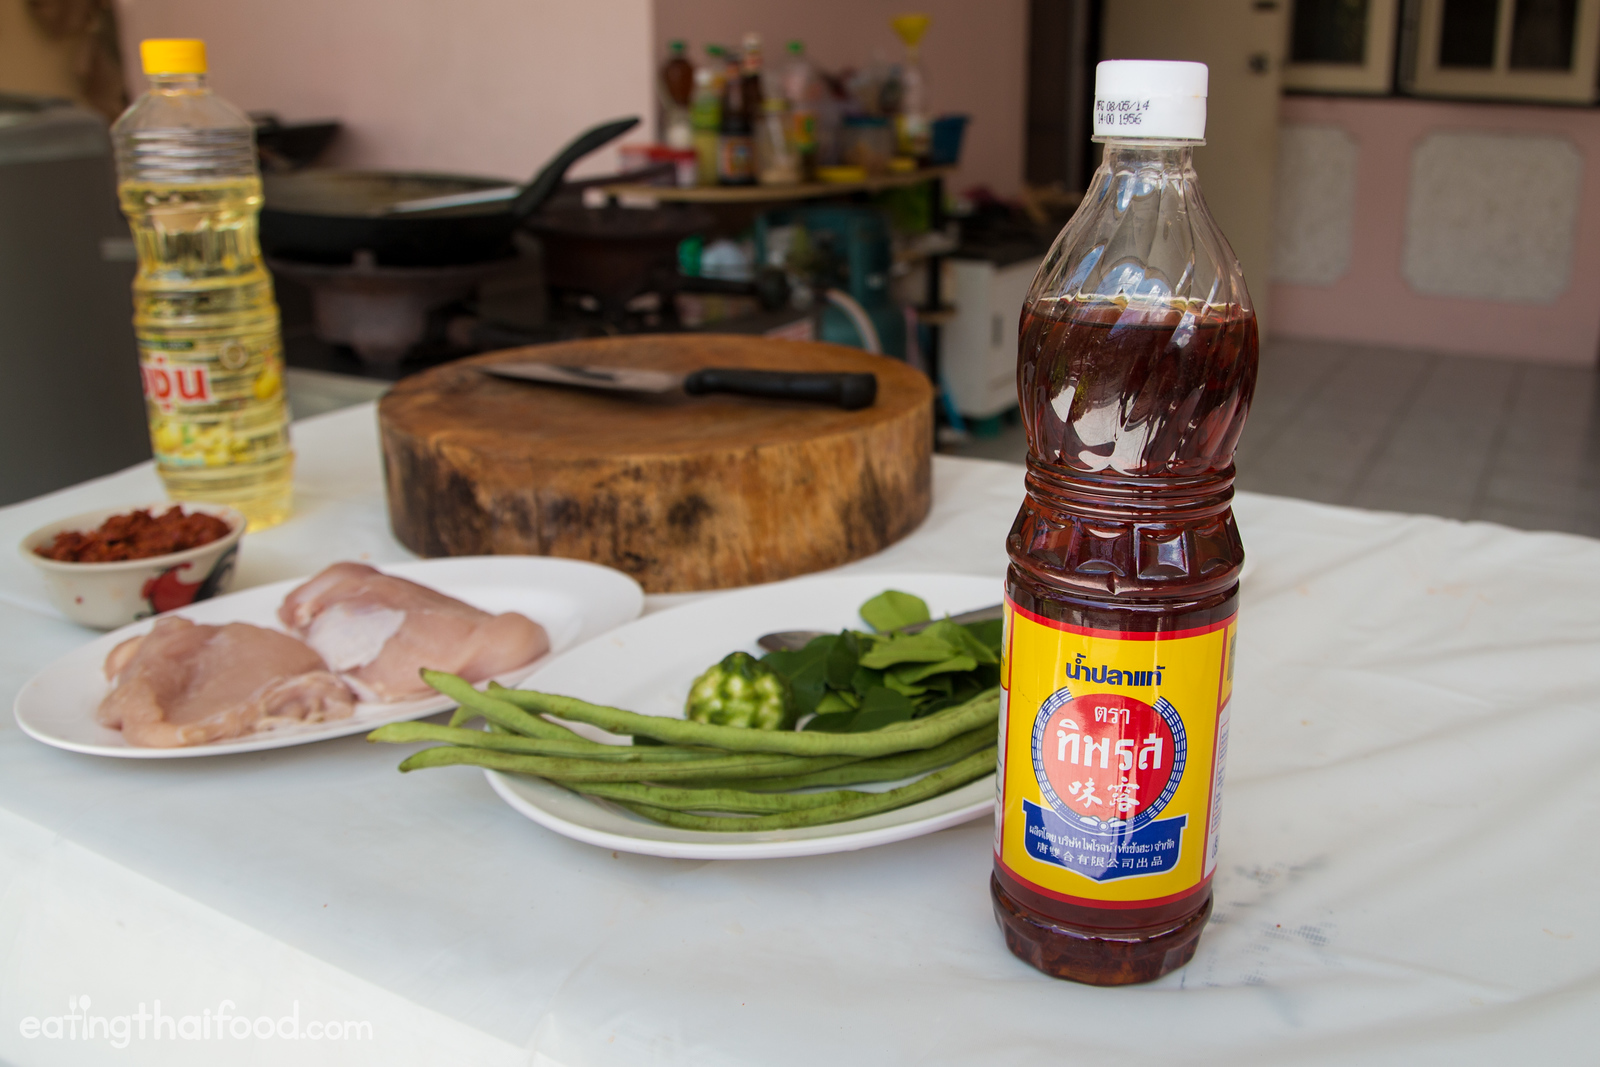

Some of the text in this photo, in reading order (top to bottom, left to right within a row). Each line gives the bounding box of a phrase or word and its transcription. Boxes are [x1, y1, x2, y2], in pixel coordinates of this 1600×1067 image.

[1065, 652, 1166, 686] น้ำปลาแท้
[1094, 706, 1131, 725] ตรา
[1056, 718, 1164, 771] ทิพรส
